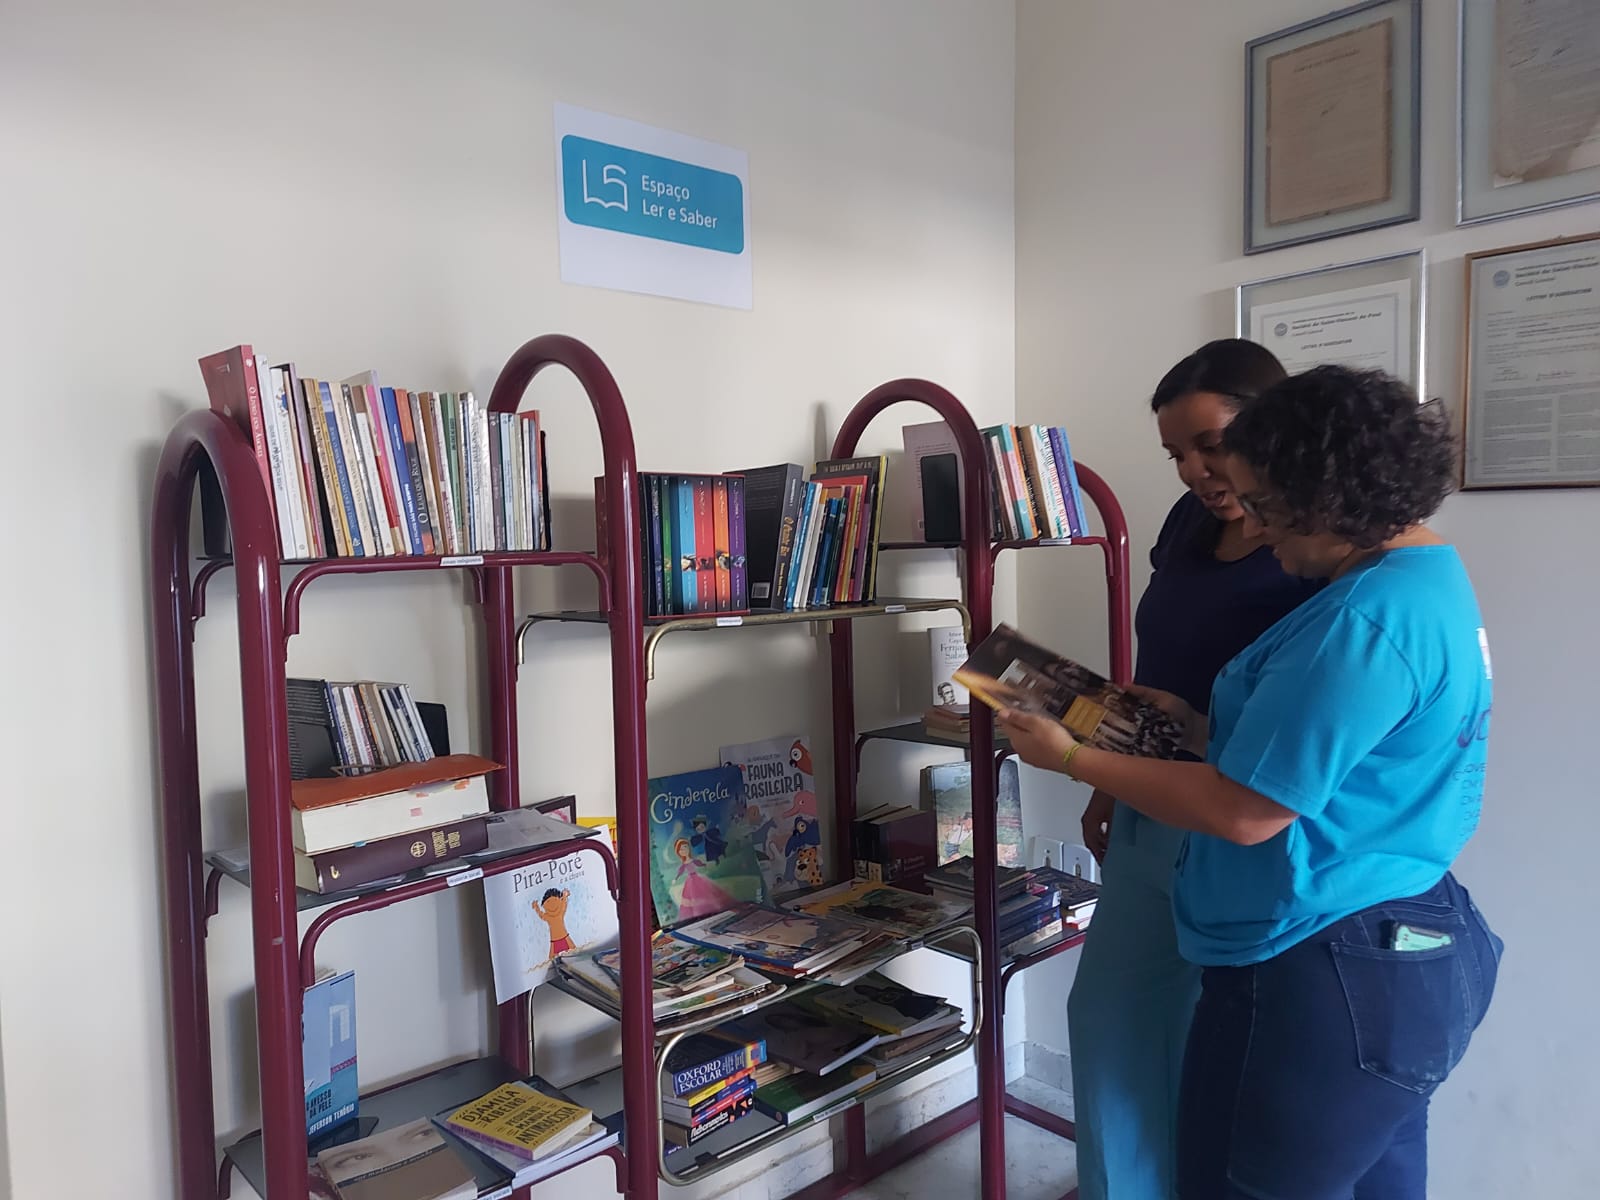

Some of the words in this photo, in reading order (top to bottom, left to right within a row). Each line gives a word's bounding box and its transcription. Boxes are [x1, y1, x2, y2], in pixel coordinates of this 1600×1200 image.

[641, 175, 689, 201] Espaço
[642, 199, 665, 217] Ler
[667, 207, 676, 221] e
[679, 208, 718, 229] Saber
[747, 762, 784, 781] FAUNA
[743, 772, 803, 800] RASILEIRA
[650, 782, 730, 824] Cinderela
[512, 852, 583, 893] Pira-Poré
[678, 1060, 721, 1084] OXFORD
[679, 1068, 722, 1093] ESCOLAR
[461, 1089, 521, 1122] DJAMILA
[480, 1100, 527, 1123] RIBEIRO
[308, 1114, 333, 1135] JEFERSON
